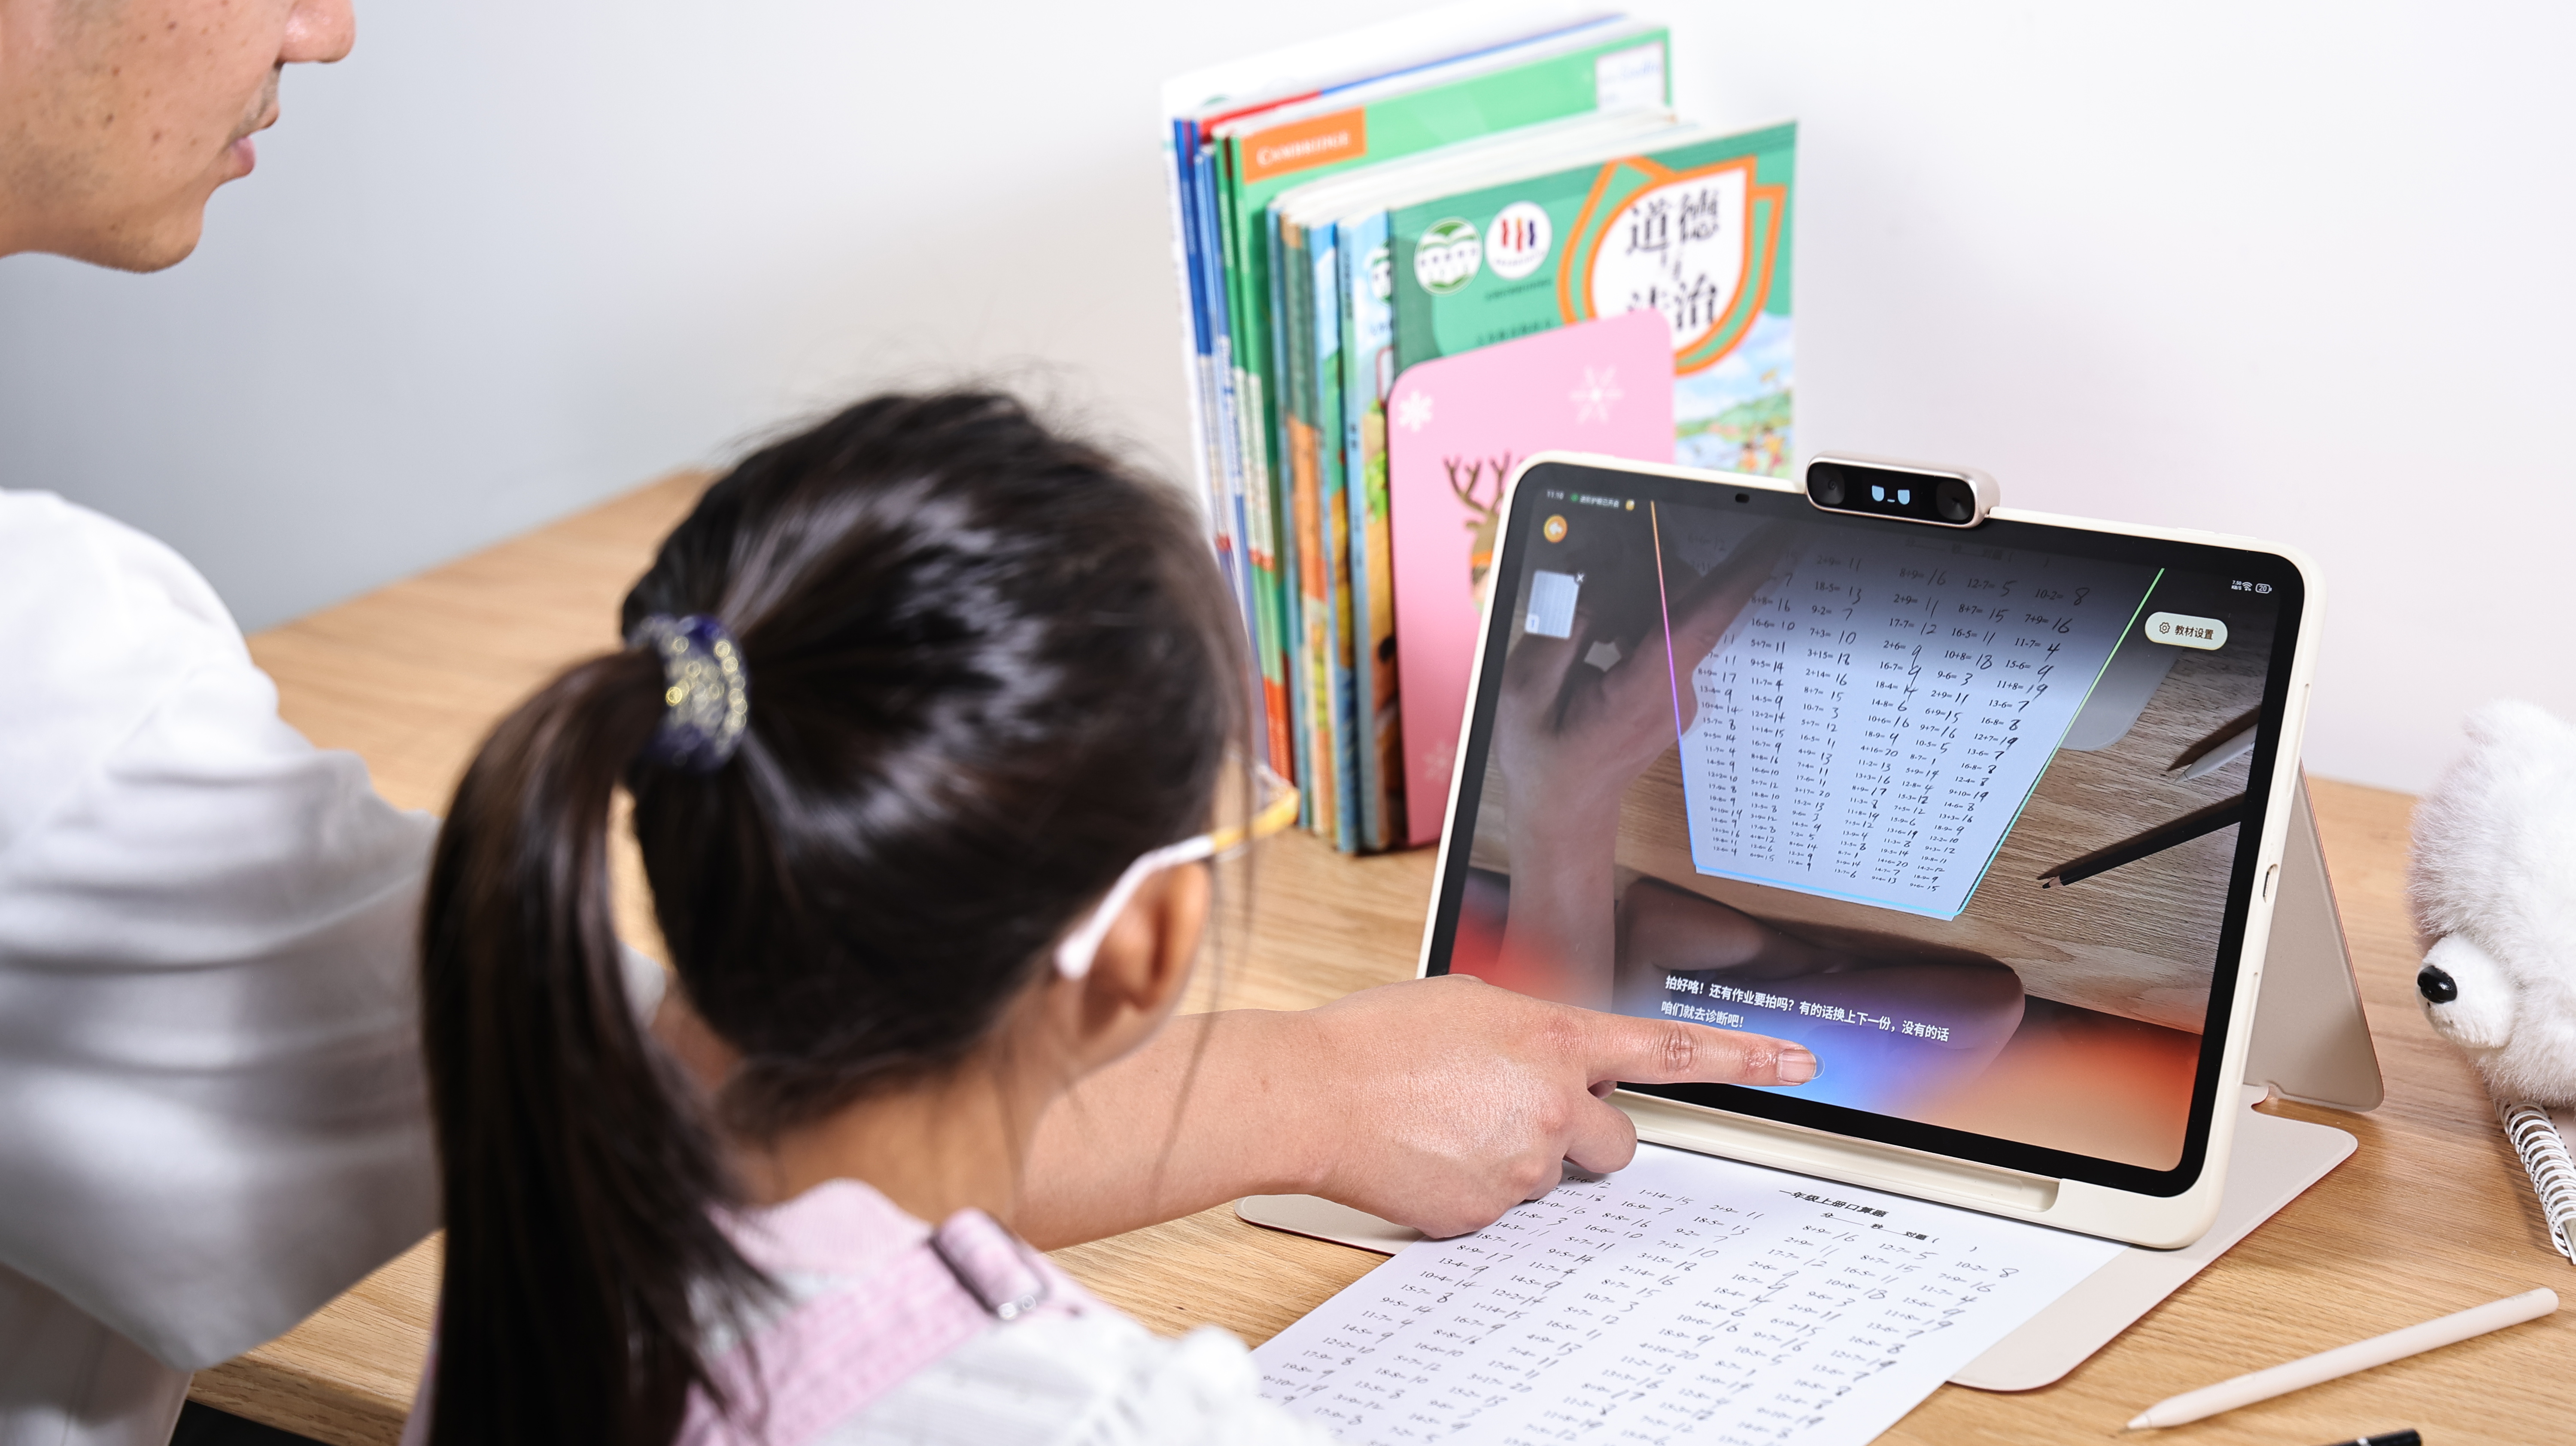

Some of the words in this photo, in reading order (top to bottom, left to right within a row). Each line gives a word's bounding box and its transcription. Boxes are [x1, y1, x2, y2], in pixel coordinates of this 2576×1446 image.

[1815, 580, 1841, 592] 18-5=
[1967, 578, 1995, 590] 12-7=
[1893, 593, 1918, 605] 2+9=
[2034, 588, 2064, 601] 10-2=
[1811, 605, 1832, 616] 9-2=
[1958, 603, 1984, 615] 8+7=
[1752, 617, 1775, 629] 16-6=
[1889, 617, 1914, 629] 17-7=
[2024, 613, 2049, 625] 7+9=
[1810, 627, 1832, 638] 7+3=
[1951, 627, 1978, 639] 16-5=
[2175, 625, 2214, 640] 教材设置
[1750, 638, 1772, 649] 5+7=
[2014, 637, 2041, 649] 11-7=
[1807, 648, 1834, 659] 3+15=
[1944, 650, 1972, 661] 10+8=
[1698, 668, 1718, 677] 8+9=
[1805, 668, 1831, 678] 2+14=
[1937, 670, 1957, 680] 9-6=
[1804, 686, 1824, 695] 8+7=
[1988, 699, 2013, 709] 13-6=
[1981, 716, 2005, 726] 16-8=
[1967, 747, 1989, 756] 13-6=
[1954, 775, 1976, 784] 12-4=
[1661, 1001, 1744, 1028] 咱们就去诊断吧！
[1567, 1175, 1596, 1185] 6+6=
[1638, 1189, 1673, 1200] 1+14=
[1620, 1200, 1652, 1210] 16-9=
[1709, 1204, 1739, 1214] 2+9=
[1778, 1189, 1890, 1218] 一年级上册口算题
[1513, 1210, 1544, 1219] 11-8=
[1601, 1212, 1631, 1221] 8+8=
[1494, 1221, 1526, 1231] 14-3=
[1692, 1216, 1725, 1226] 18-5=
[1583, 1224, 1616, 1234] 16-6=
[1674, 1227, 1701, 1237] 9-2=
[1801, 1225, 1832, 1235] 8+9=
[1475, 1233, 1508, 1243] 18-7=
[1564, 1236, 1594, 1246] 5+7=
[1783, 1236, 1814, 1247] 2+9=
[1456, 1244, 1485, 1254] 8+9=
[1657, 1239, 1685, 1249] 7+3=
[1878, 1242, 1911, 1254] 12-7=
[1546, 1248, 1576, 1258] 9+5=
[1637, 1252, 1674, 1264] 3+15=
[1768, 1249, 1800, 1259] 17-7=
[1437, 1257, 1470, 1268] 13-4=
[1859, 1254, 1890, 1264] 8+7=
[1619, 1265, 1655, 1277] 2+14=
[1955, 1261, 1988, 1272] 10-2=
[1400, 1283, 1432, 1295] 15-7=
[1601, 1279, 1630, 1289] 8+7=
[1380, 1297, 1409, 1308] 9+5=
[1583, 1292, 1616, 1303] 10-7=
[1361, 1310, 1393, 1322] 11-7=
